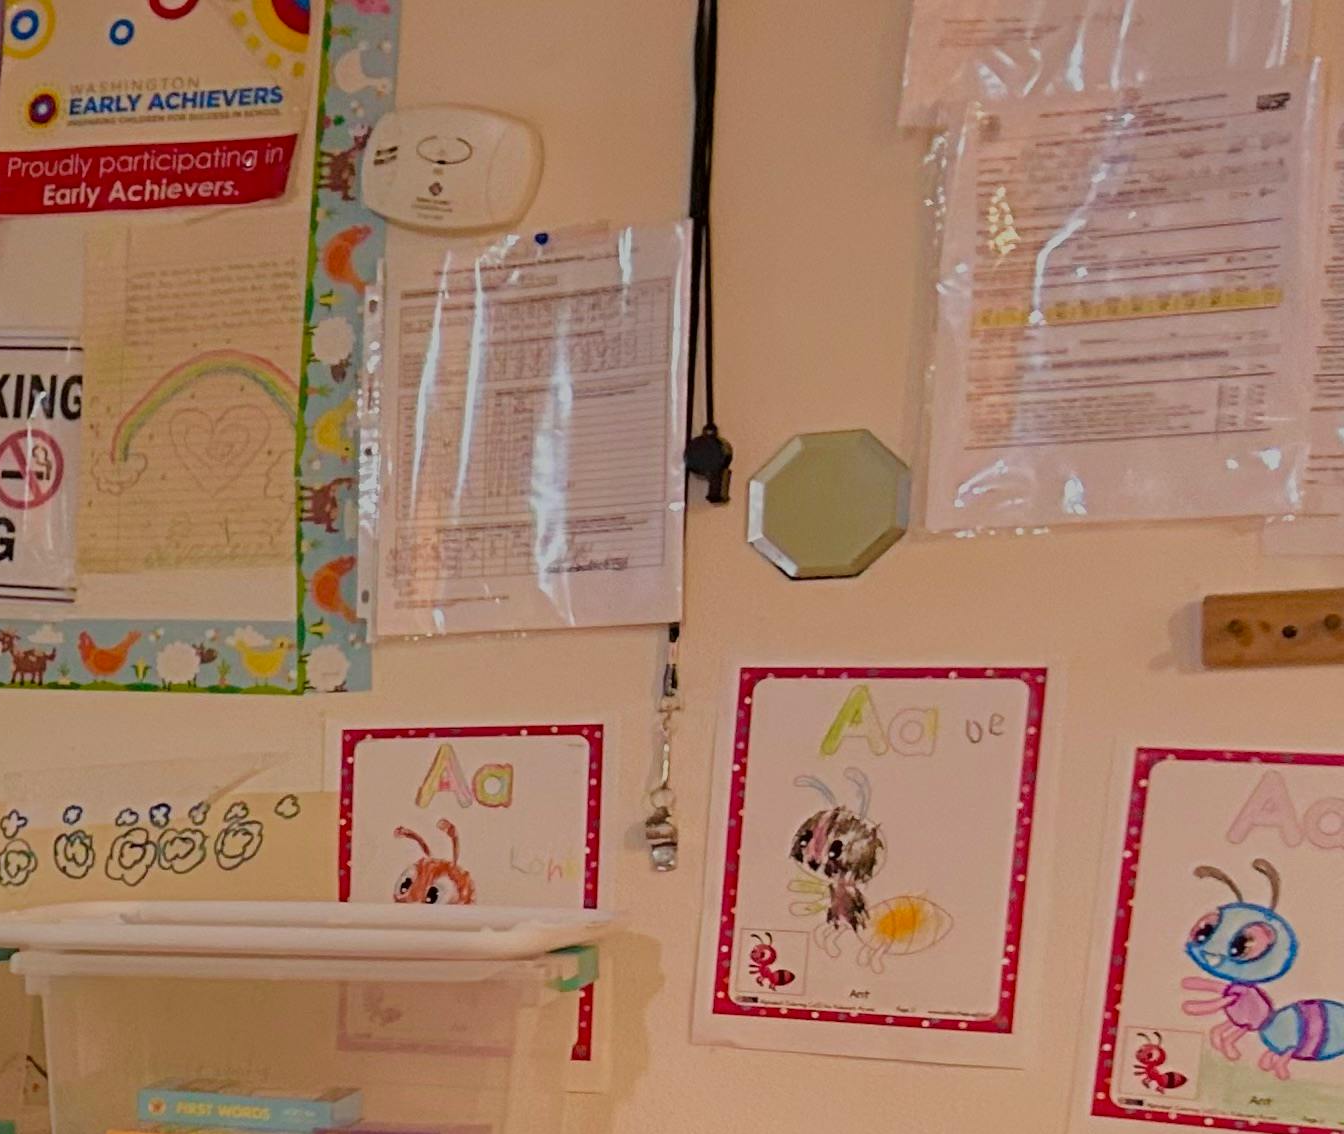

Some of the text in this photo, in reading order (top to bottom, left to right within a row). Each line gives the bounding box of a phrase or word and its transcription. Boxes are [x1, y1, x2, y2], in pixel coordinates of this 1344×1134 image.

[70, 77, 200, 93] WASHINGTON
[69, 86, 283, 116] EARLY ACHIEVERS
[8, 143, 283, 177] Proudly participating in
[43, 178, 239, 208] Early Achievers.
[415, 742, 514, 810] Aa
[176, 1101, 213, 1116] FIRST
[218, 1104, 272, 1121] WORDS
